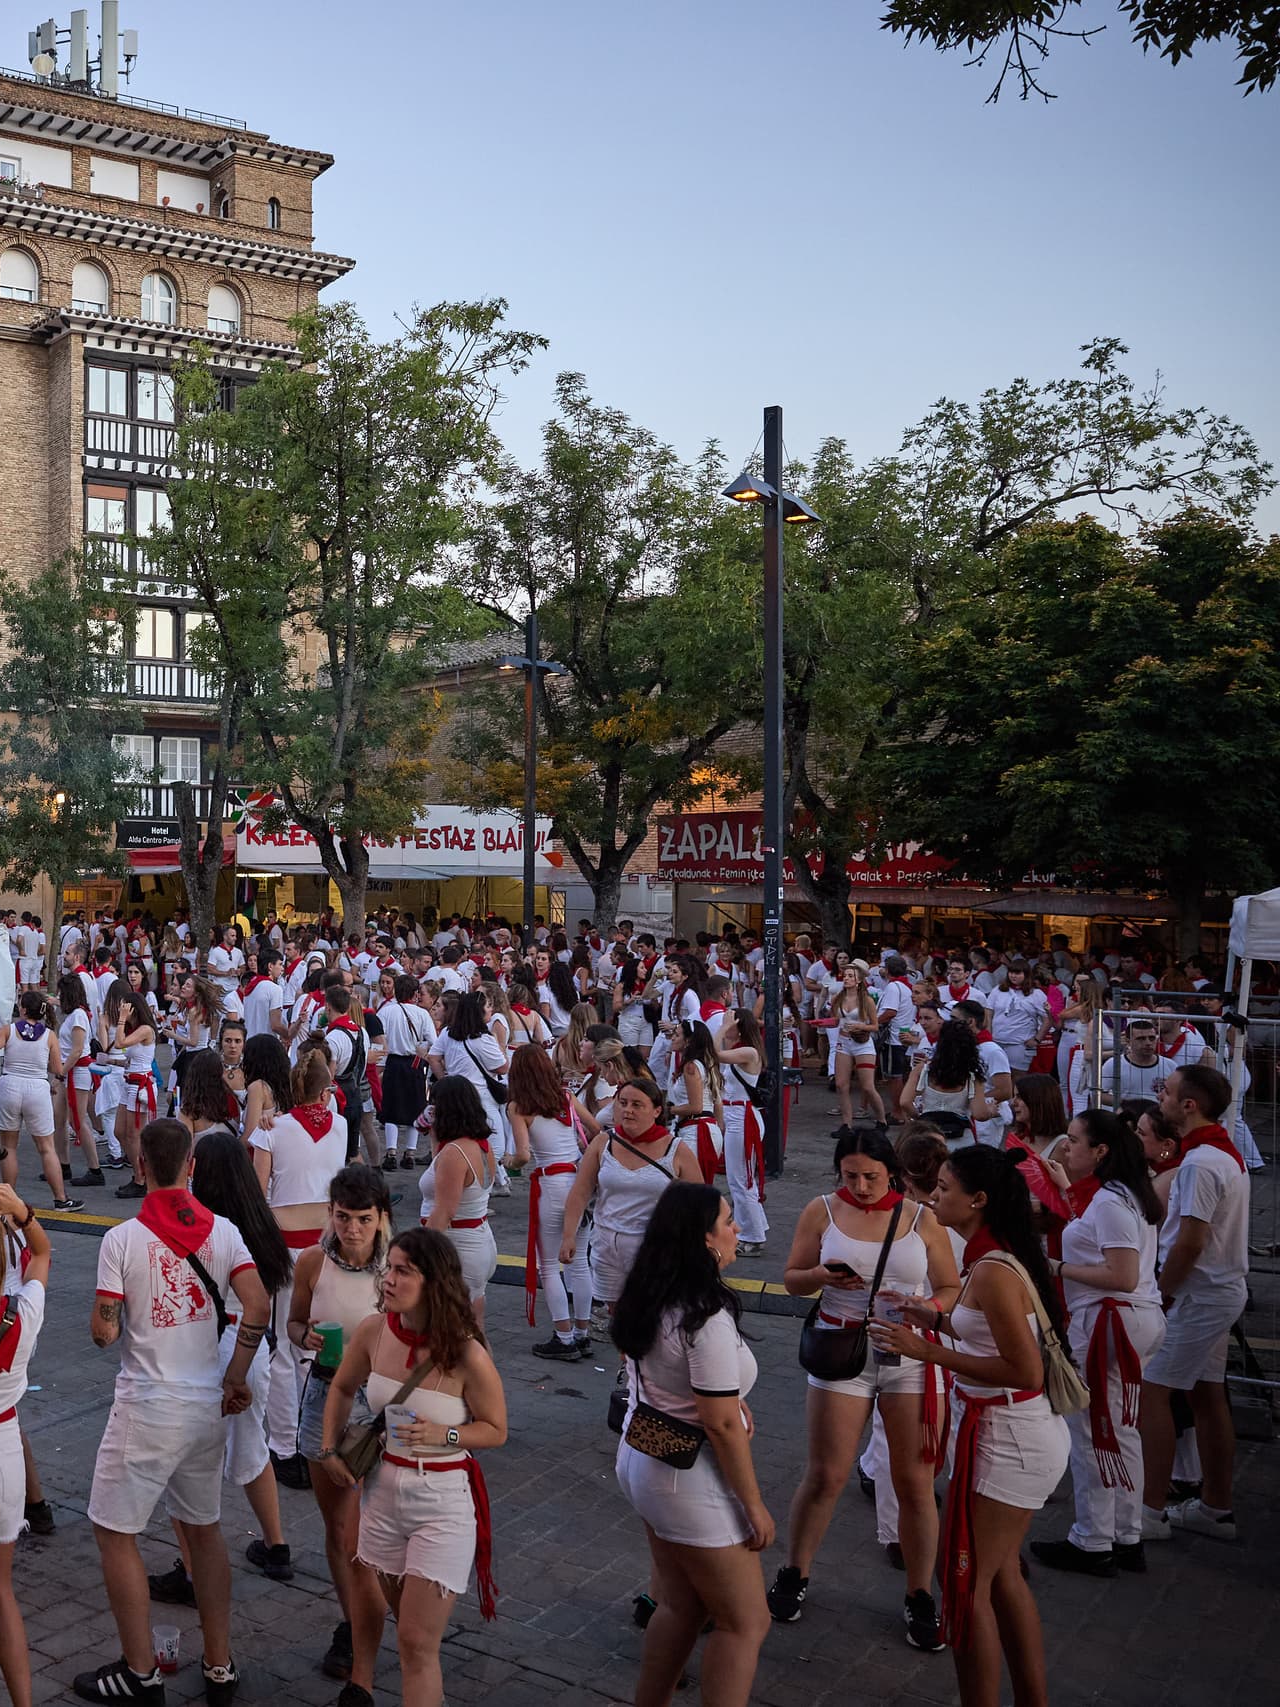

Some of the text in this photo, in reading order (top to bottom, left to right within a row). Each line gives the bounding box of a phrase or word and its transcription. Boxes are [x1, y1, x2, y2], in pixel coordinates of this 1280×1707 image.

[151, 826, 169, 835] Hotel
[246, 822, 321, 847] KALEA
[127, 836, 182, 845] Alda Centro Pampl
[658, 867, 711, 880] Euskaldunak
[719, 867, 765, 881] Feminista
